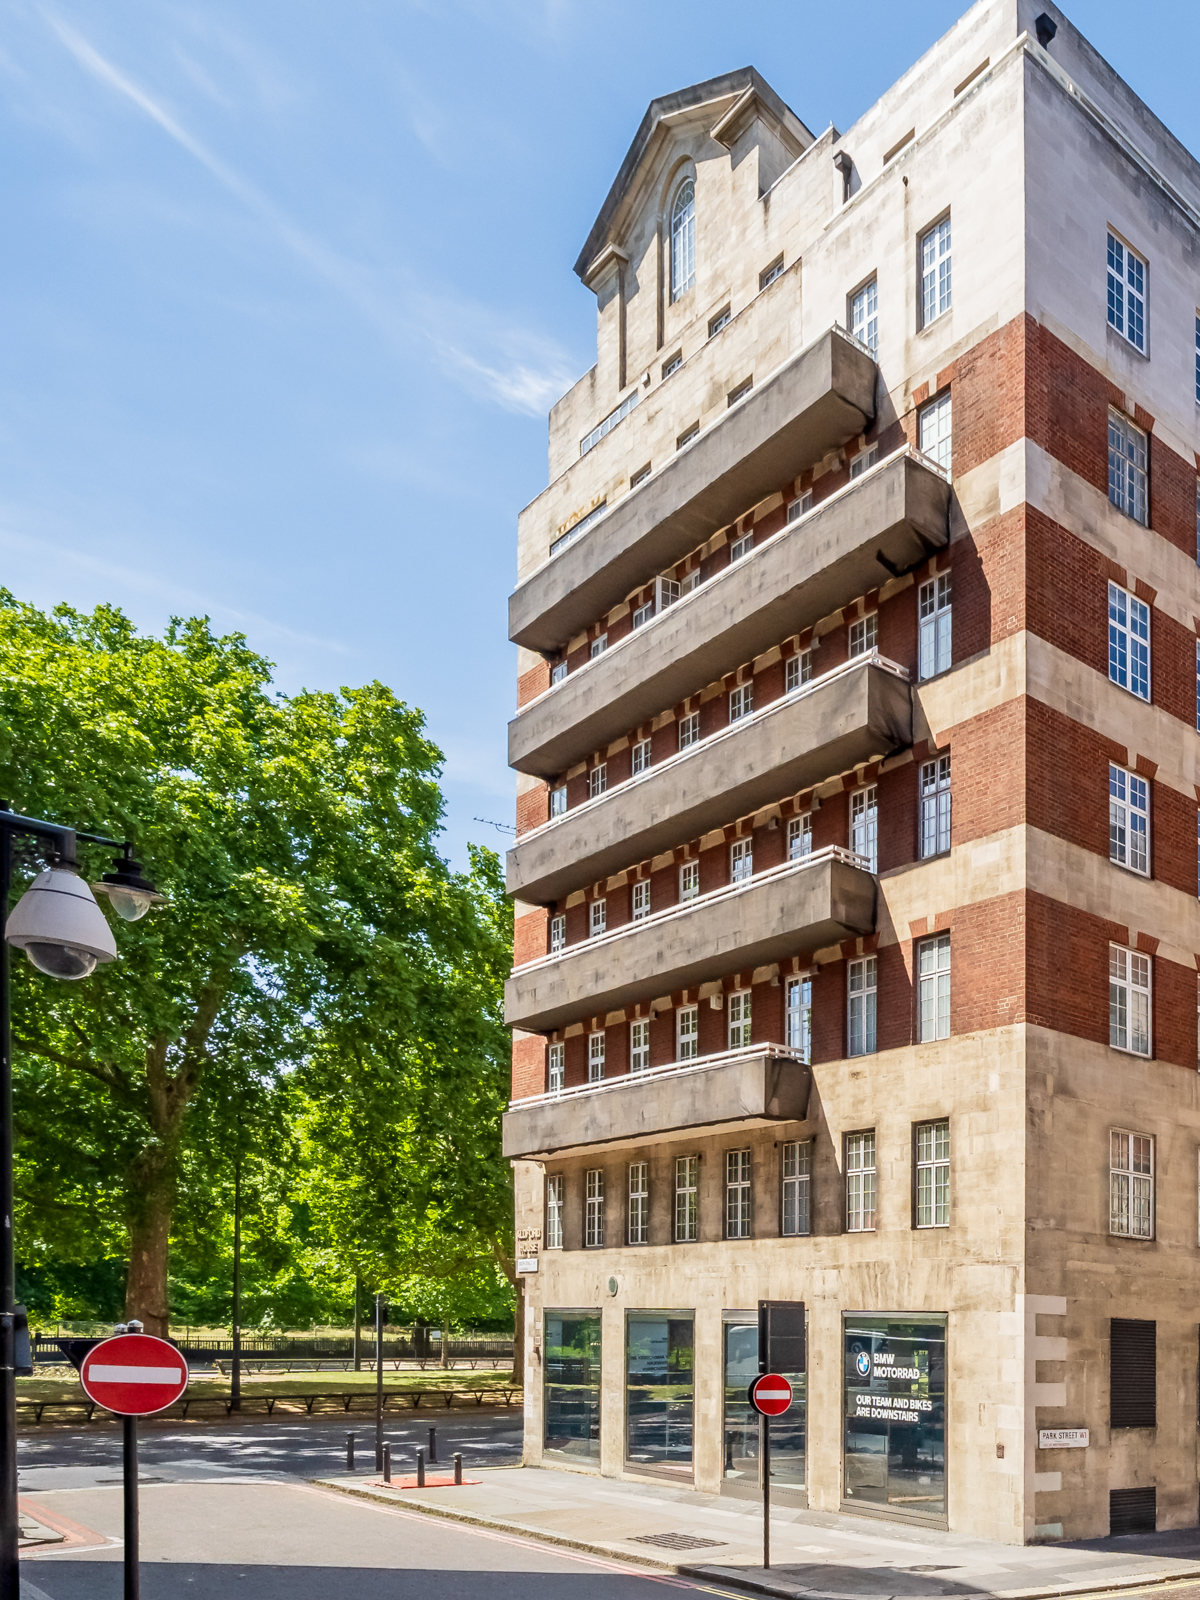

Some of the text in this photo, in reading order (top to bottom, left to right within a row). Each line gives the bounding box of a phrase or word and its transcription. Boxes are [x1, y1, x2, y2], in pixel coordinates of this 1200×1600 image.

[874, 1354, 895, 1365] BMW
[873, 1367, 920, 1379] MOTORRAD
[856, 1395, 933, 1411] OUR TEAM AND BIKES
[856, 1407, 919, 1422] ARE DOWNSTAIRS
